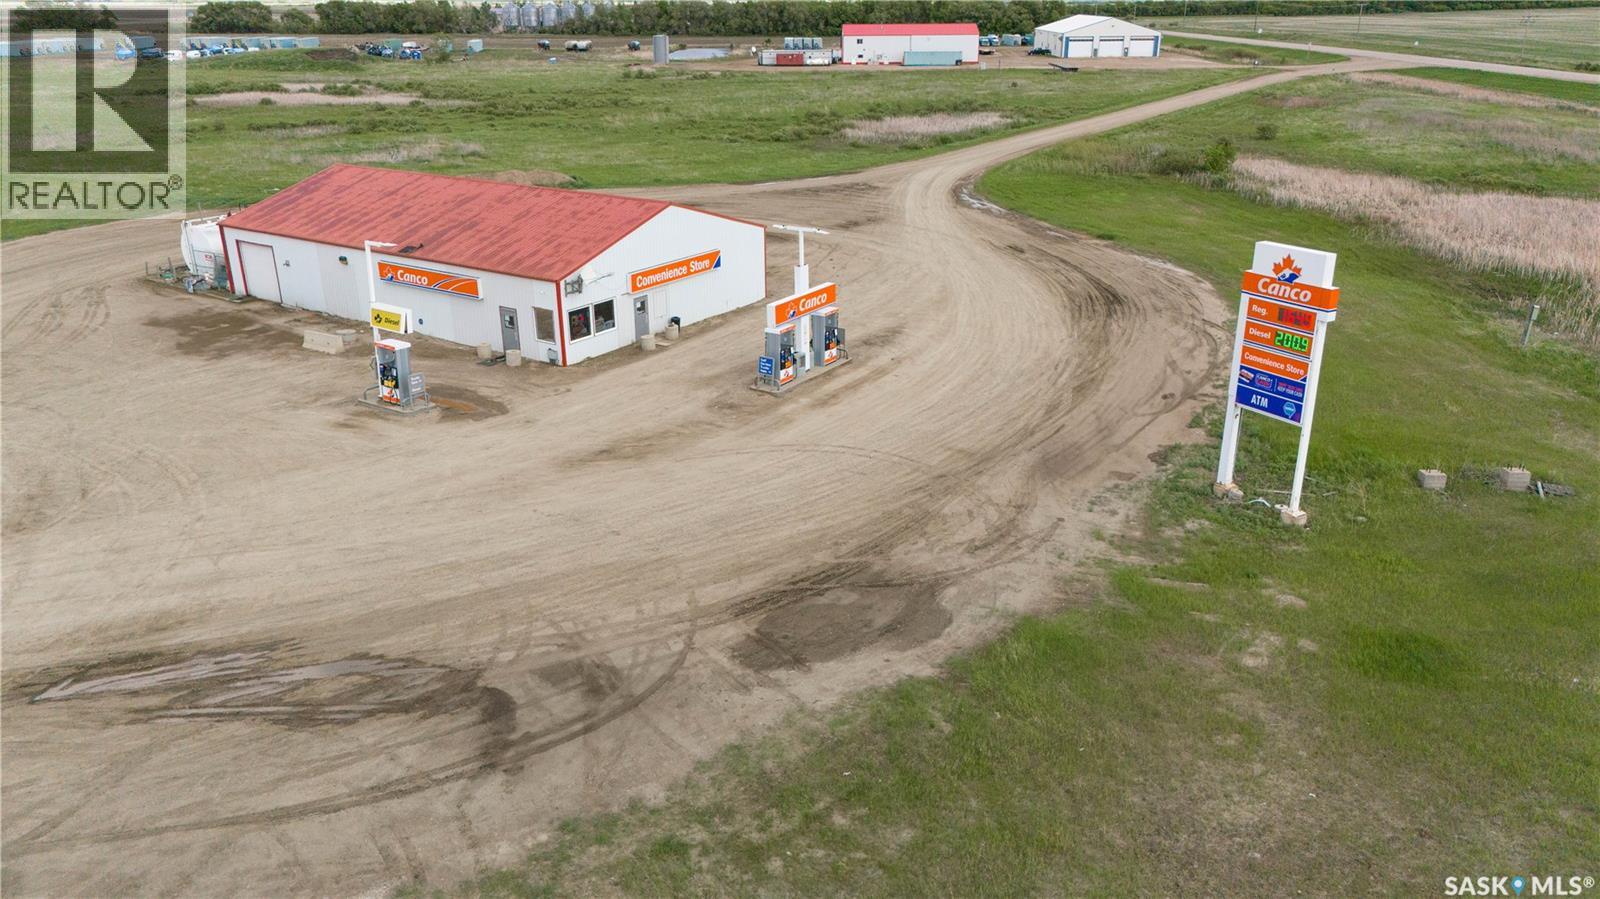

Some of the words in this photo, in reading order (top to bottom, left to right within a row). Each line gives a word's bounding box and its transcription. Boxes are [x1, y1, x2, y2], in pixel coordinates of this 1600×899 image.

[397, 269, 428, 286] Canco
[636, 265, 687, 288] Convenience
[689, 258, 710, 273] Store
[1257, 277, 1312, 302] Canco
[799, 292, 827, 312] Canco
[384, 317, 400, 326] Diesel
[1249, 327, 1271, 340] Diesel
[1244, 351, 1285, 371] Convenience
[1286, 363, 1305, 377] Store
[1250, 394, 1269, 408] ATM
